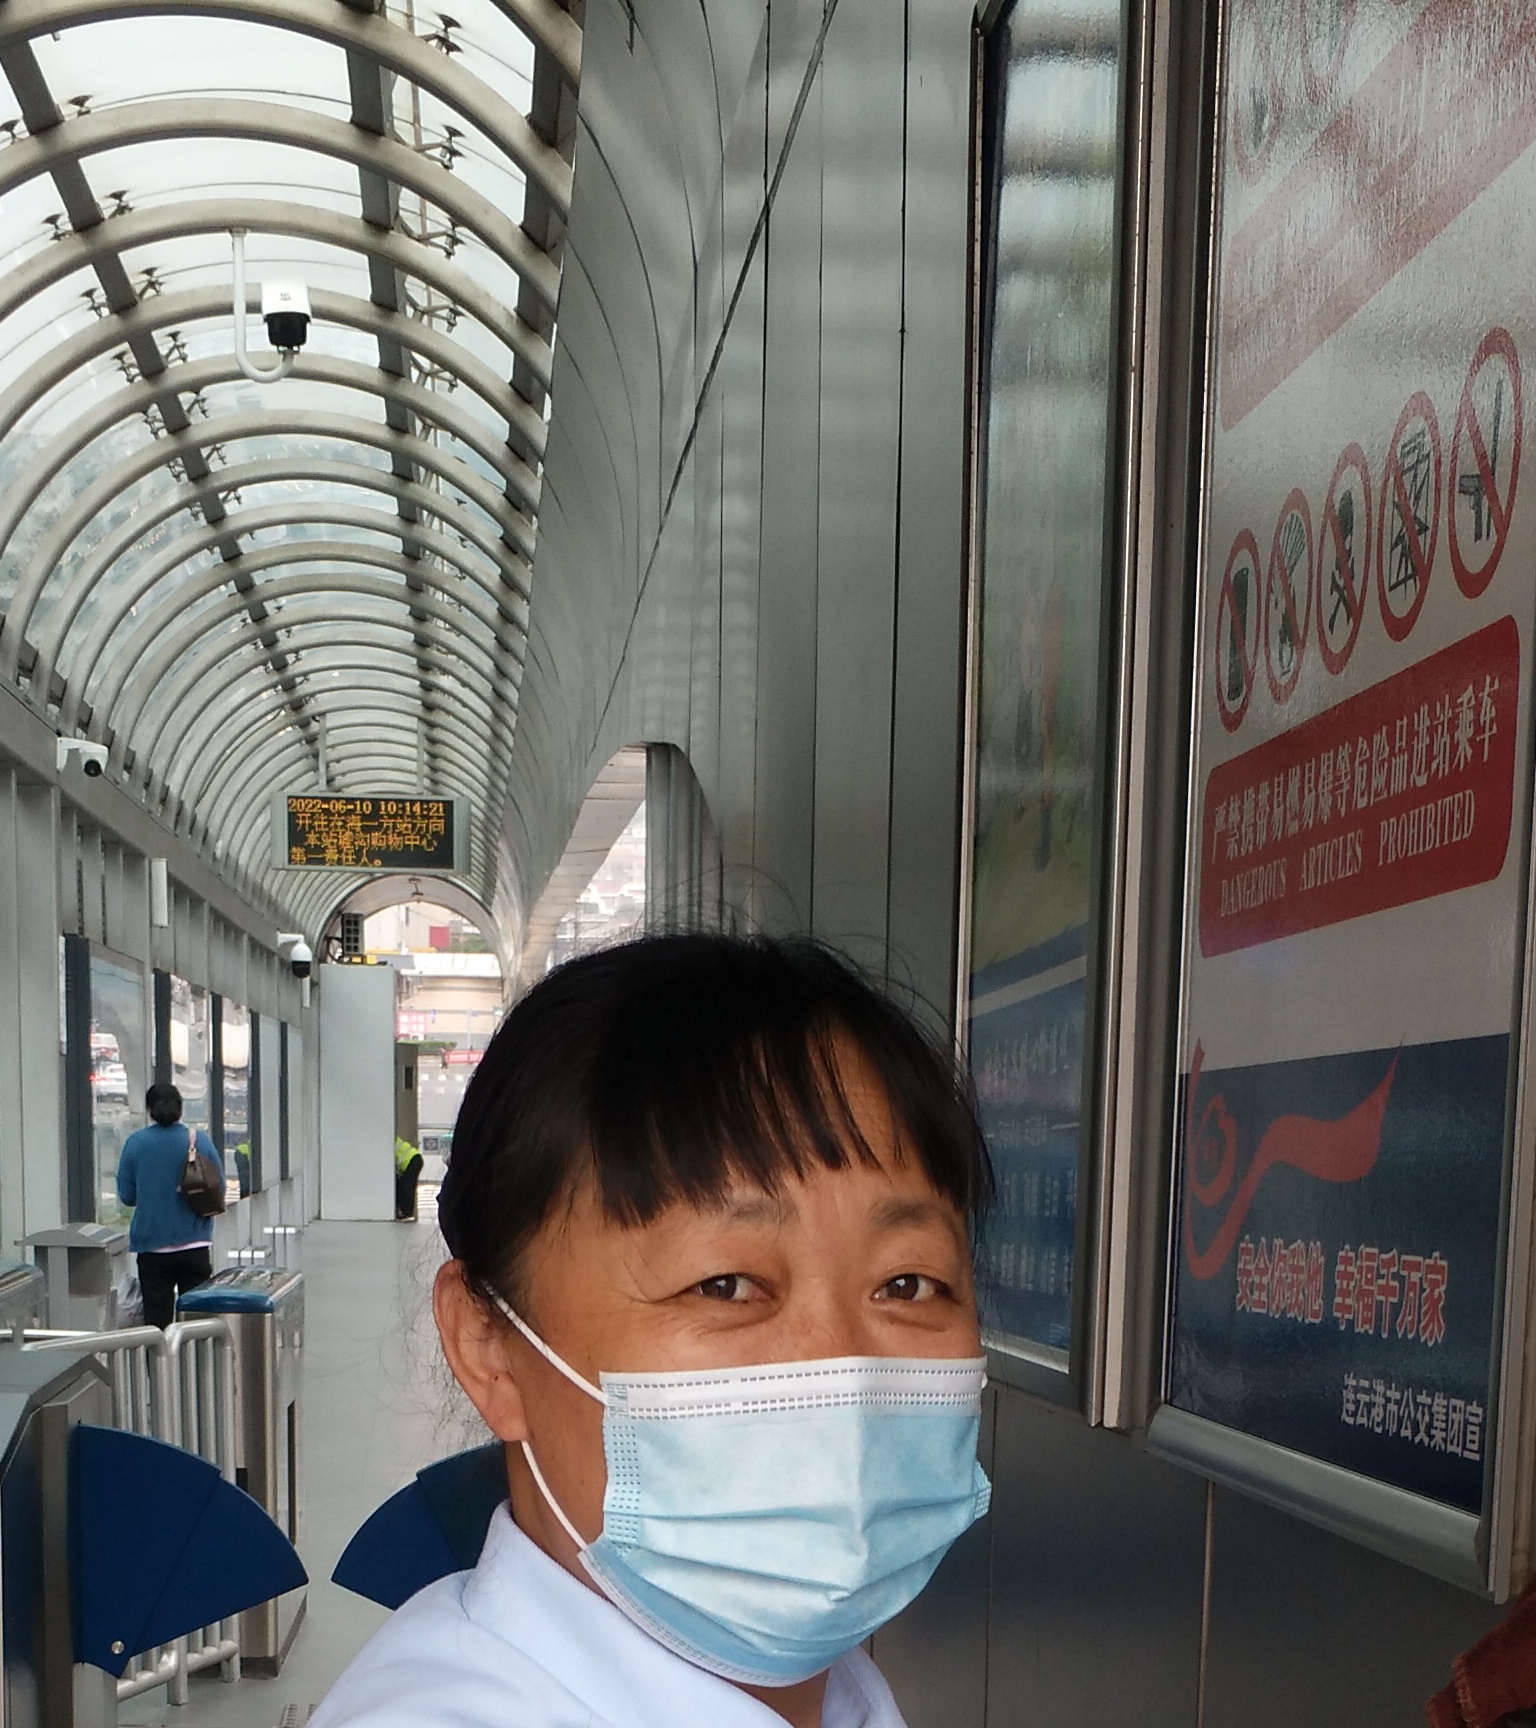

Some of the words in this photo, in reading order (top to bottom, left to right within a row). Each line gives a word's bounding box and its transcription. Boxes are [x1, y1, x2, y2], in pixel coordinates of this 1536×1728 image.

[288, 798, 372, 815] 2022-06-10
[379, 801, 445, 816] 10:14:21
[1212, 674, 1500, 864] 严禁携带易燃易爆等危险品进站乘车
[1220, 857, 1287, 918] DANGEROUS
[1300, 838, 1362, 894] ARTICLES
[1379, 790, 1474, 864] PROHIBITED
[1236, 1235, 1324, 1325] 安全你我他
[1334, 1243, 1449, 1345] 幸福千万家
[1341, 1372, 1484, 1462] 连云港市公交集团宣
